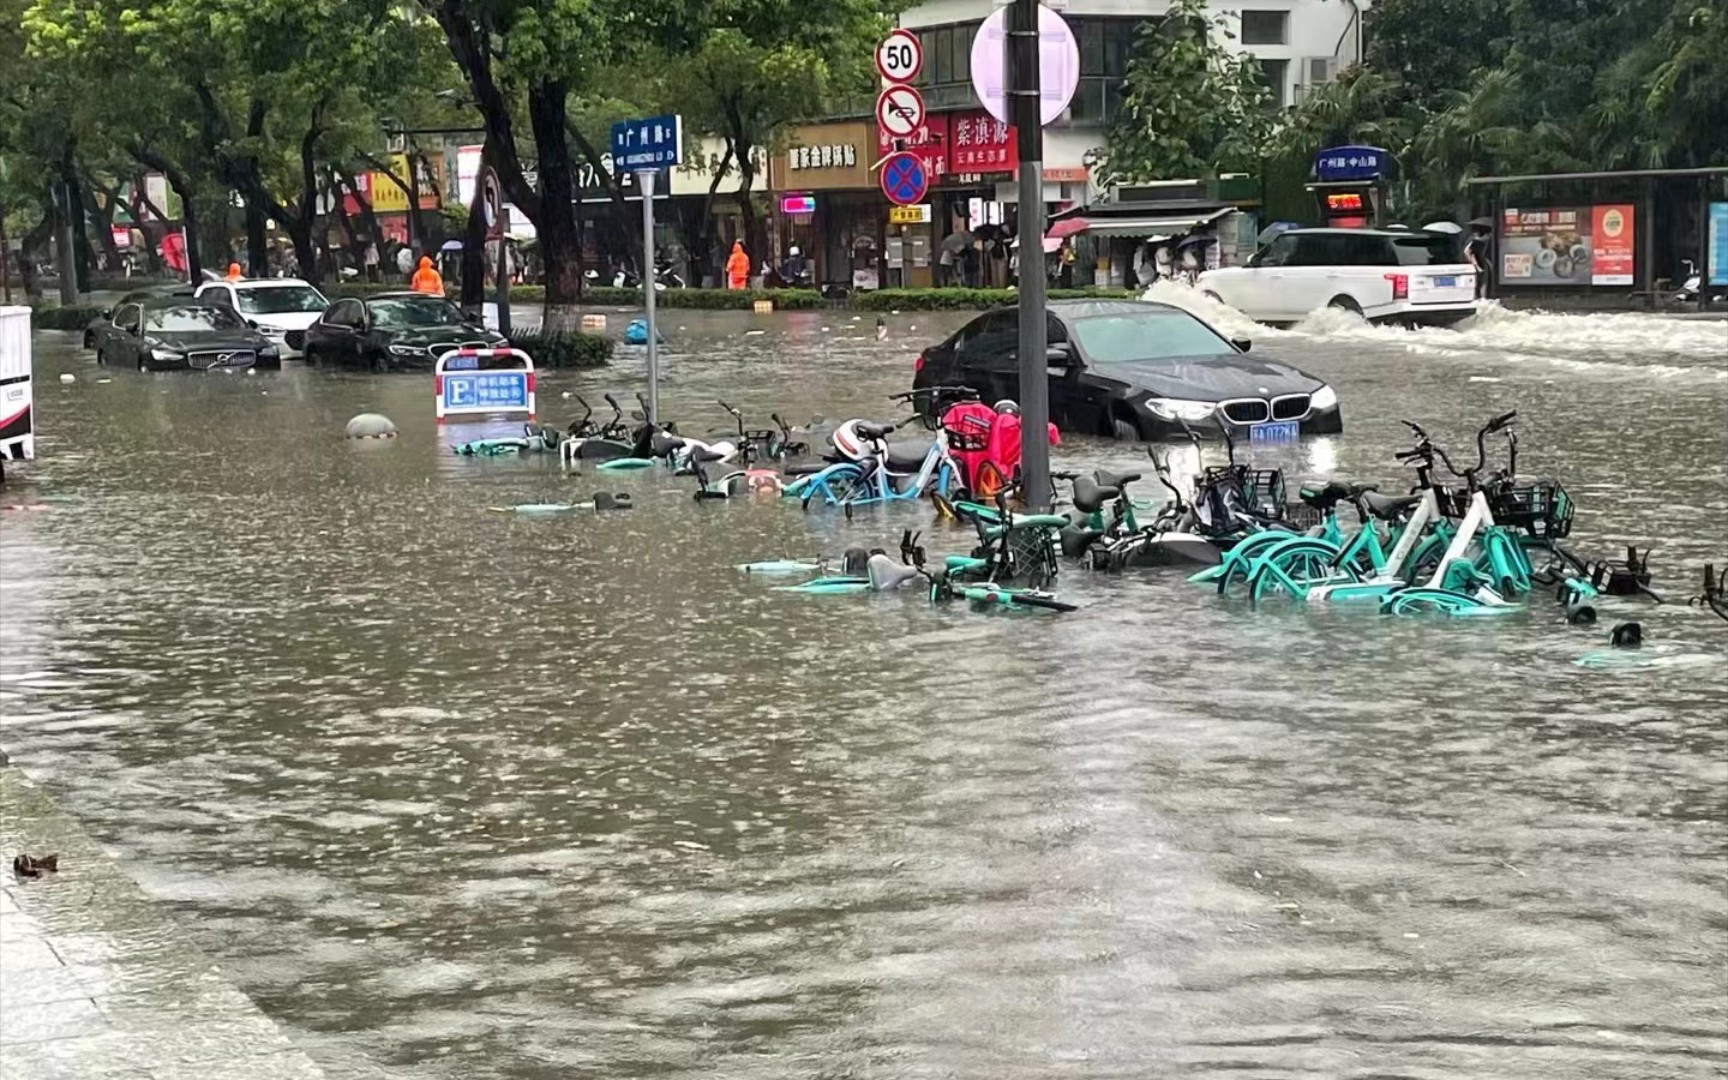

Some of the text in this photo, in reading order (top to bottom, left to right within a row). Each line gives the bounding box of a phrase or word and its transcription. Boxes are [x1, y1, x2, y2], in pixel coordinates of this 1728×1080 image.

[887, 45, 912, 69] 50
[626, 125, 663, 147] 广州路
[450, 380, 470, 404] P
